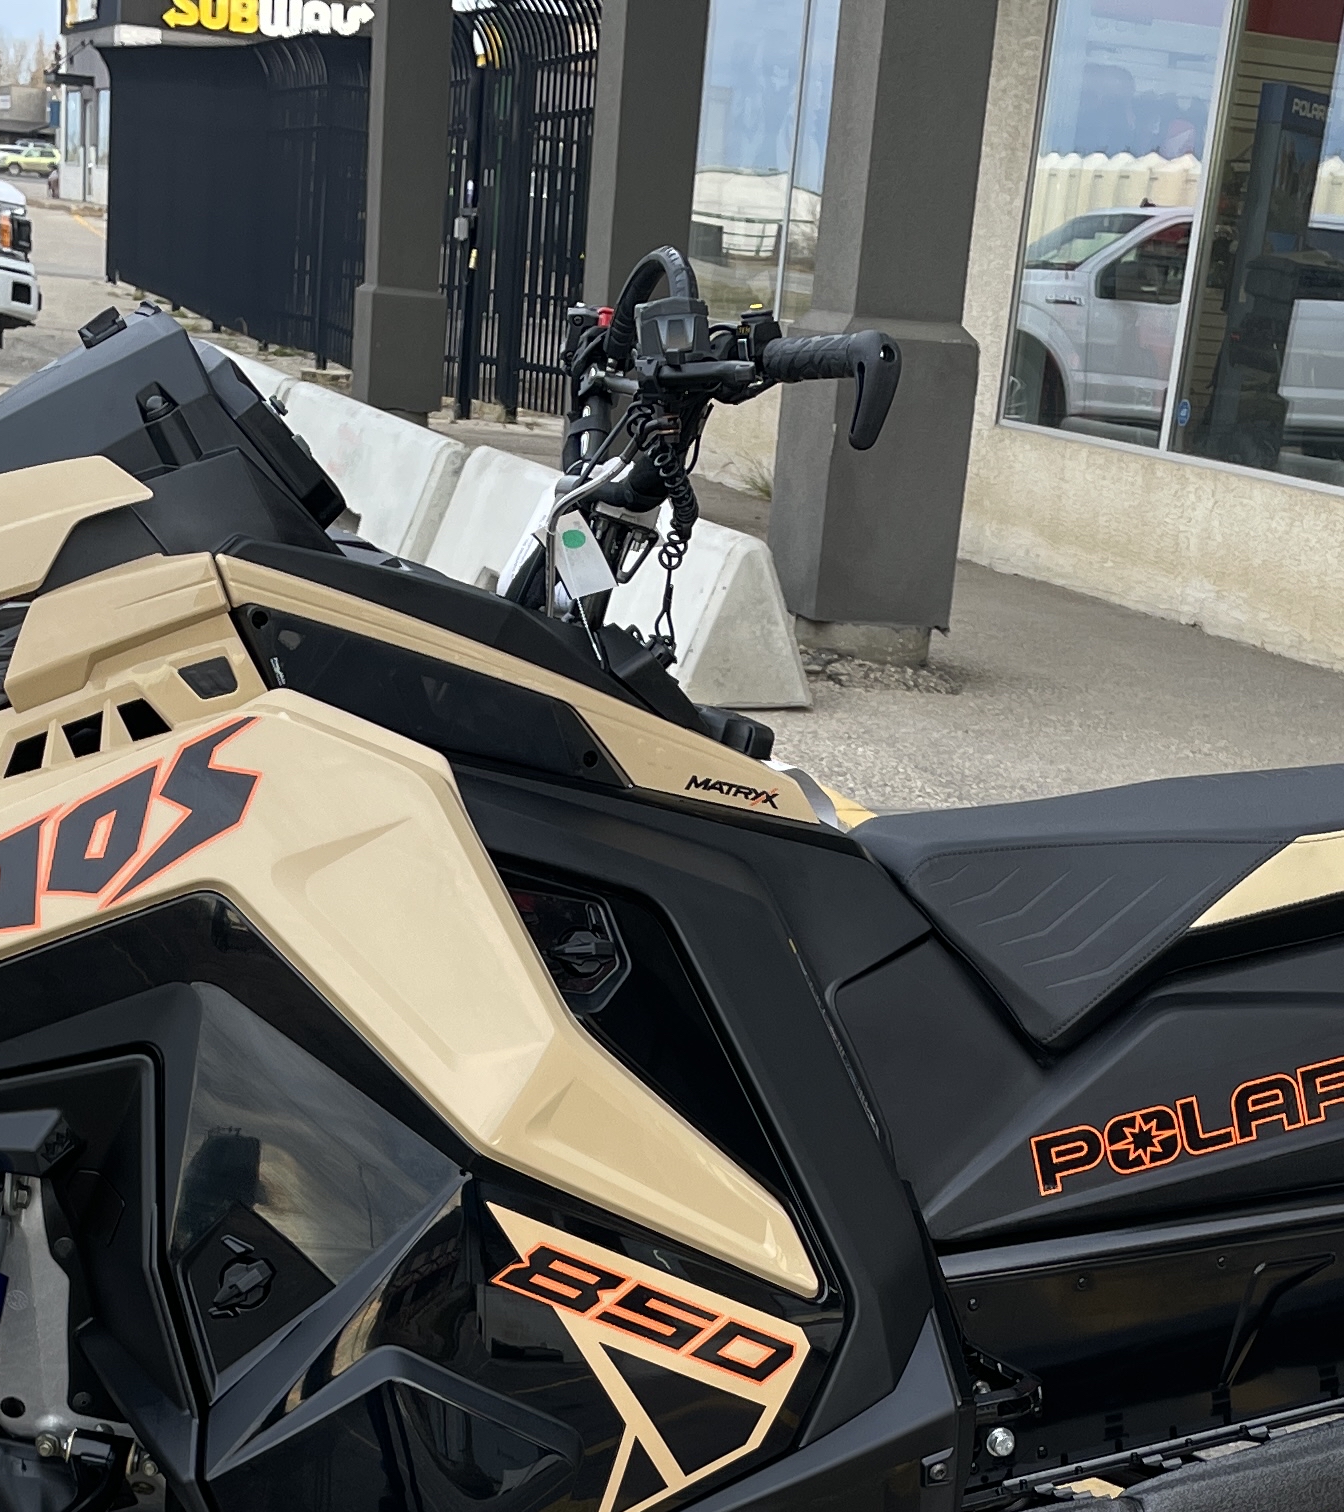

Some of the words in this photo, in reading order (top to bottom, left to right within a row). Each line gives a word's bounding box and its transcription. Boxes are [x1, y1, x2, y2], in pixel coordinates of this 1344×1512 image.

[1292, 98, 1331, 120] POLAR
[684, 775, 779, 810] MATRYX
[490, 1241, 797, 1387] 850
